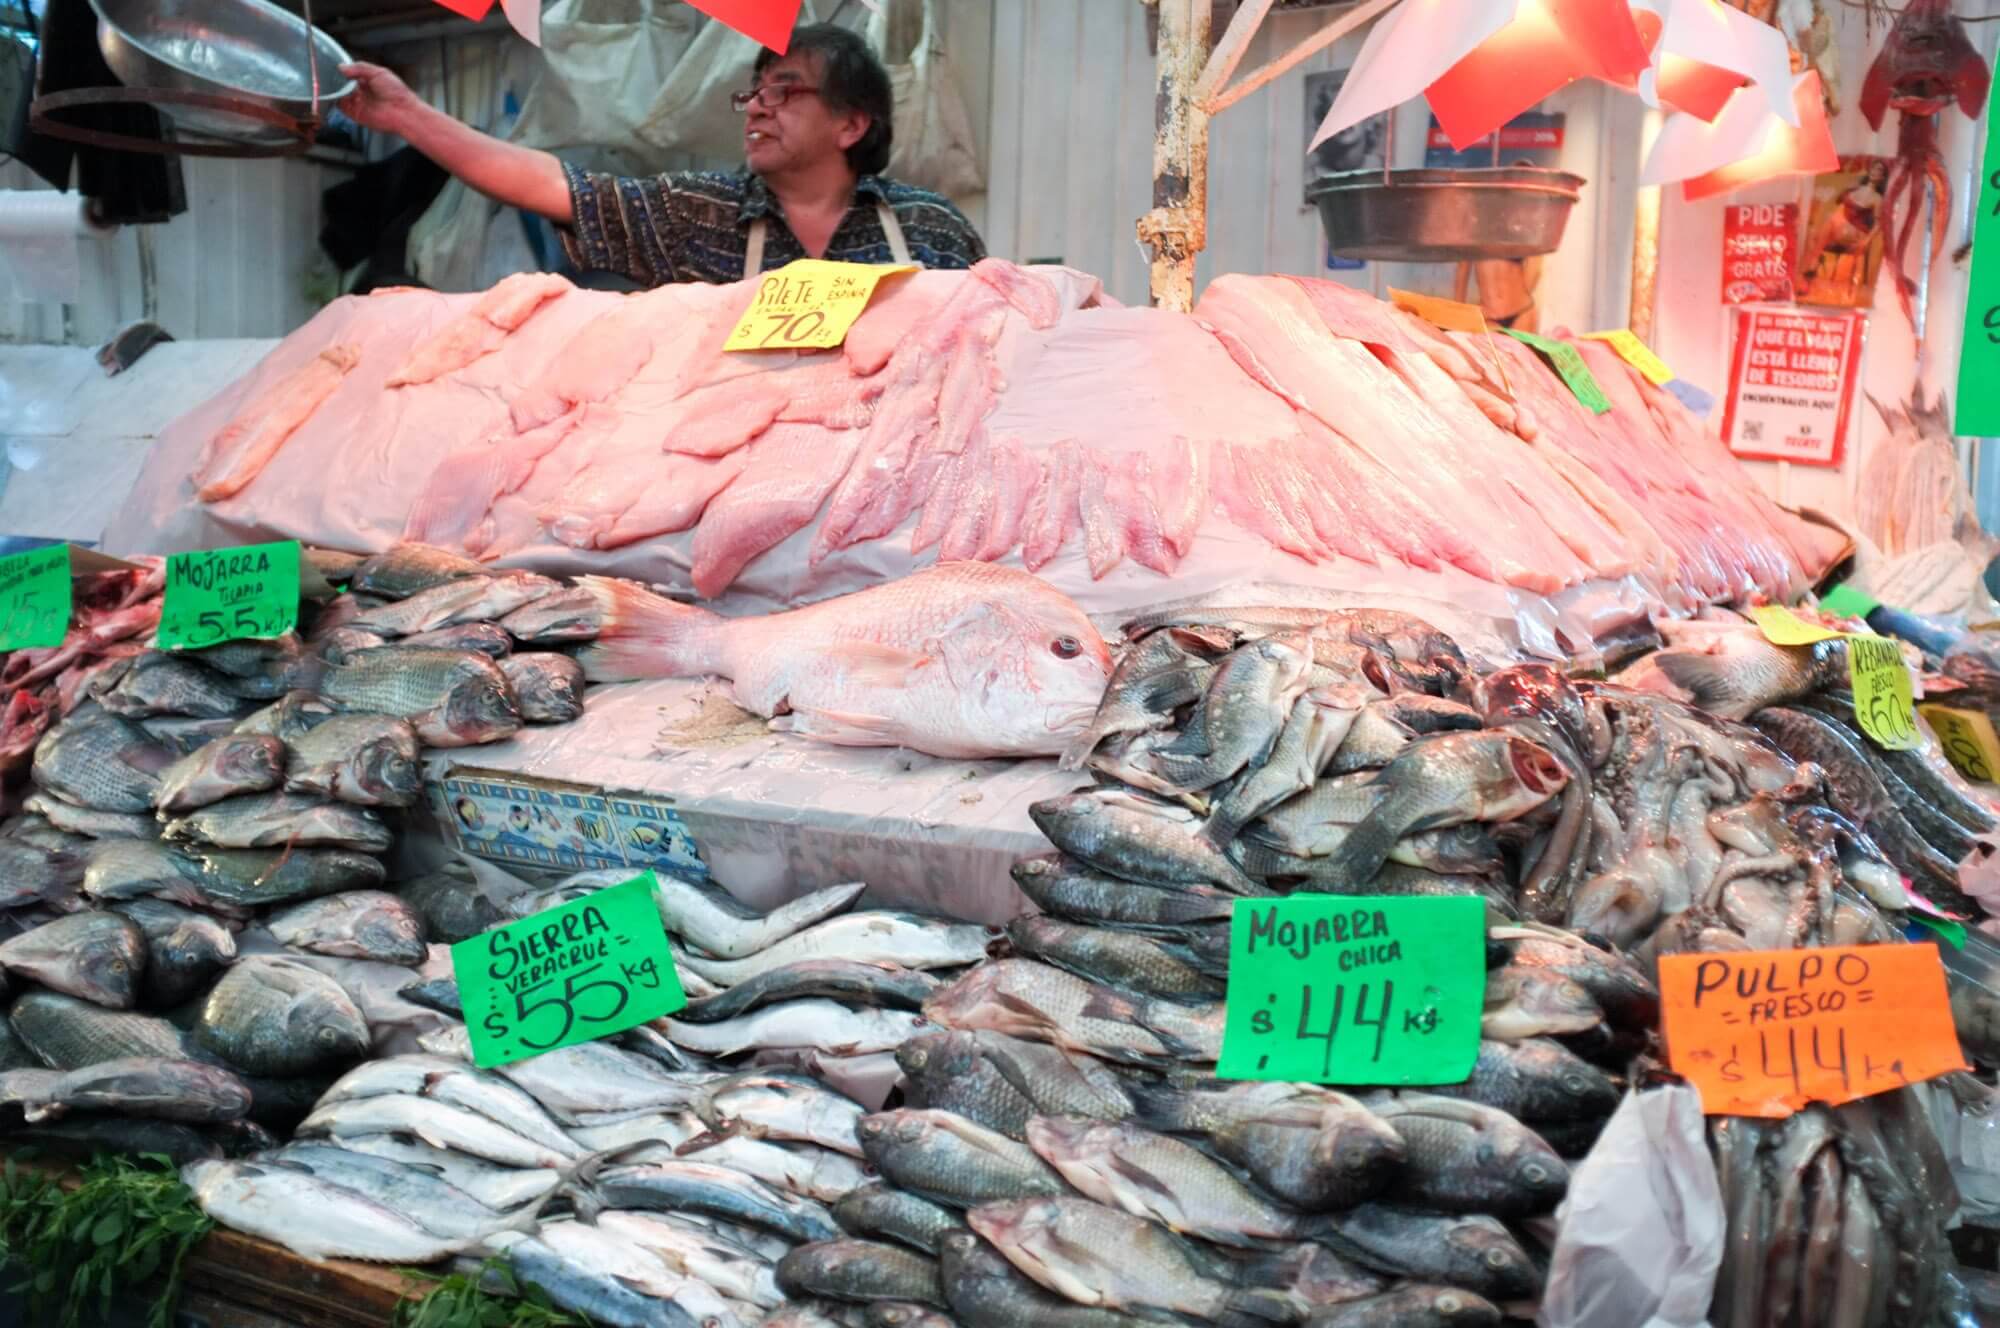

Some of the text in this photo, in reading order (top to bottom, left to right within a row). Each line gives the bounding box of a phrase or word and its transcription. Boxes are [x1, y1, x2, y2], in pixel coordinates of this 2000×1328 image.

[1738, 204, 1785, 227] PIDE
[832, 275, 856, 287] SIN
[1733, 259, 1788, 278] GRATIS
[760, 311, 825, 345] 70
[1755, 328, 1784, 347] QUE
[1788, 331, 1804, 346] EL
[1751, 347, 1839, 370] ESTÁ LLENO
[1749, 368, 1838, 389] DE TESOROS
[175, 552, 271, 592] MOJARRA
[1870, 694, 1909, 745] 60
[487, 906, 610, 980] SIERRA
[1248, 906, 1390, 960] MOJARRA
[1338, 941, 1402, 972] CHICA
[1694, 954, 1870, 1008] PULPO
[516, 964, 629, 1049] 55
[619, 957, 661, 989] kg
[1749, 989, 1846, 1025] FRESCO
[1296, 980, 1394, 1078] 44
[1761, 1027, 1850, 1096] 44
